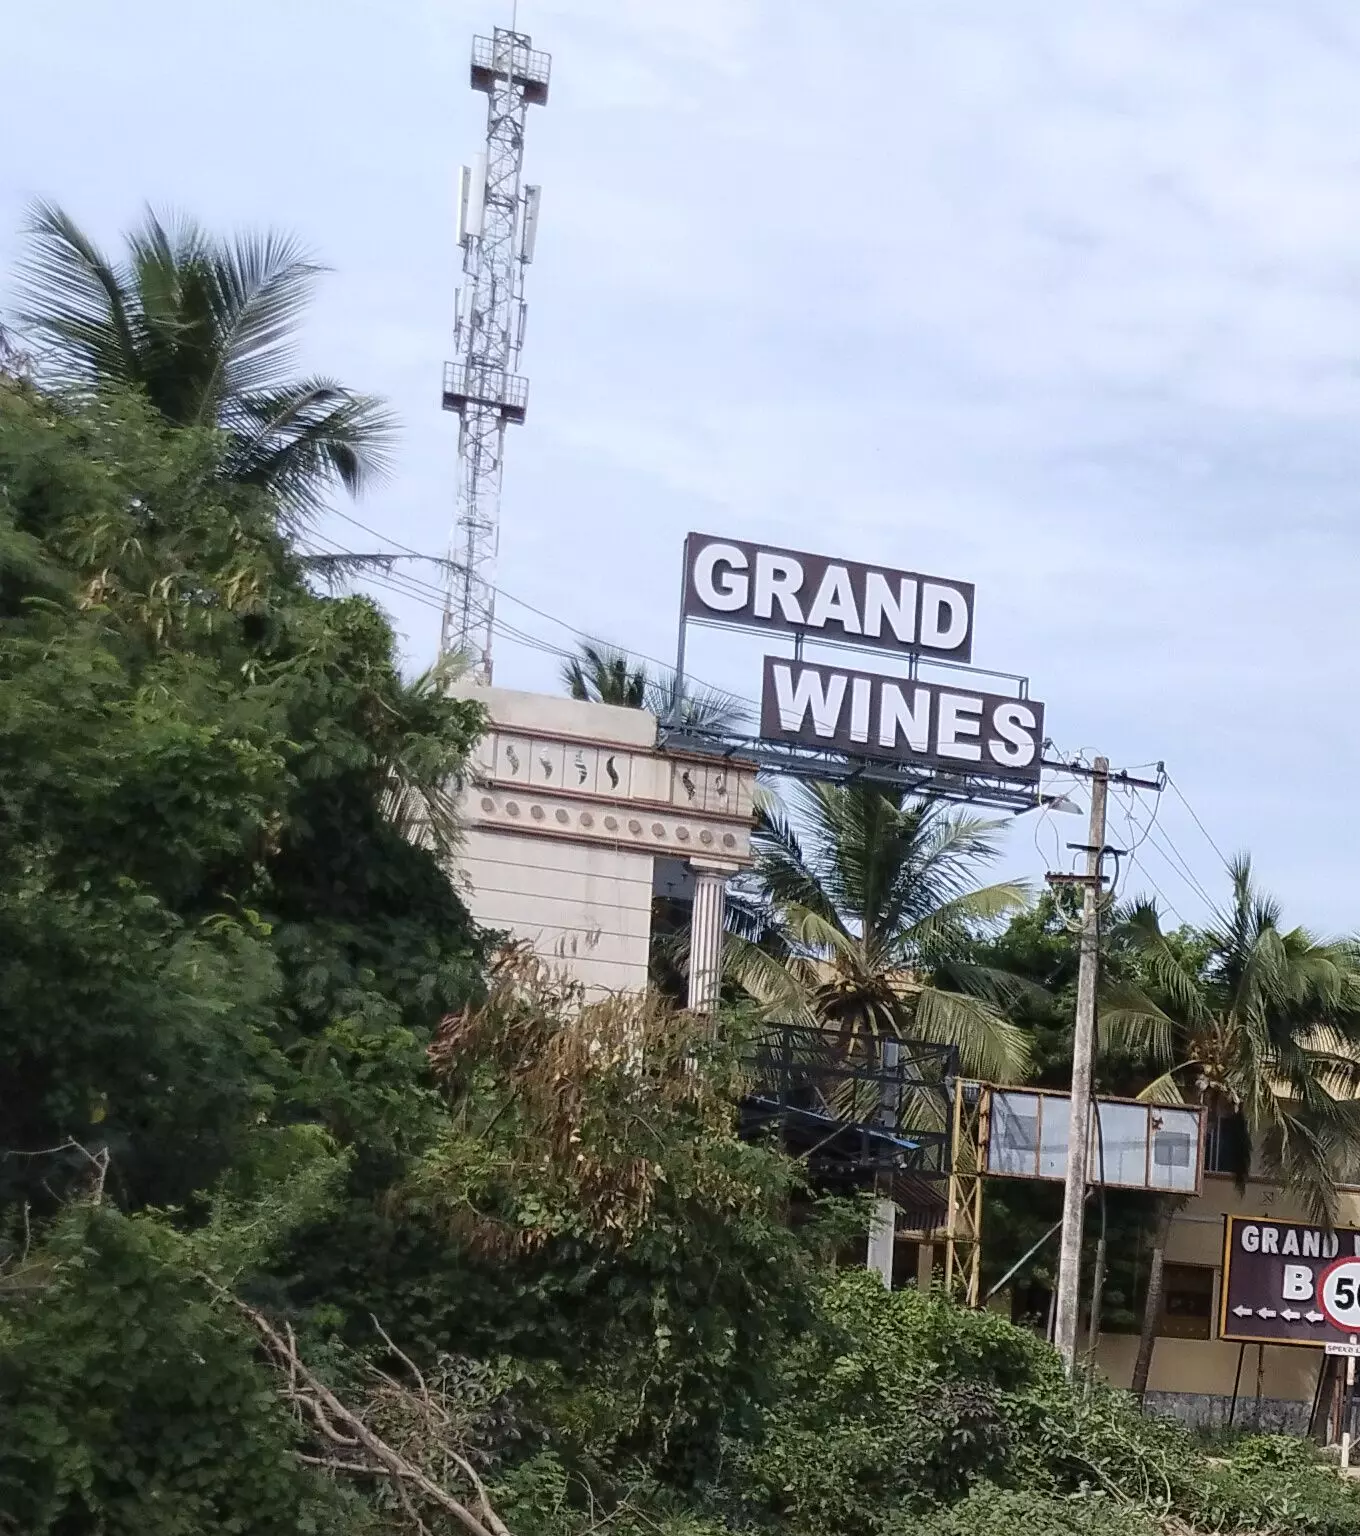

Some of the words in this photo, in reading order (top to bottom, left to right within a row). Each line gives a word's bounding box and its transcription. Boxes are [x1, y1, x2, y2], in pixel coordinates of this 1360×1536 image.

[694, 544, 968, 650] GRAND
[772, 664, 1036, 768] WINES
[1241, 1225, 1339, 1258] GRAND
[1327, 1344, 1353, 1353] SPEED
